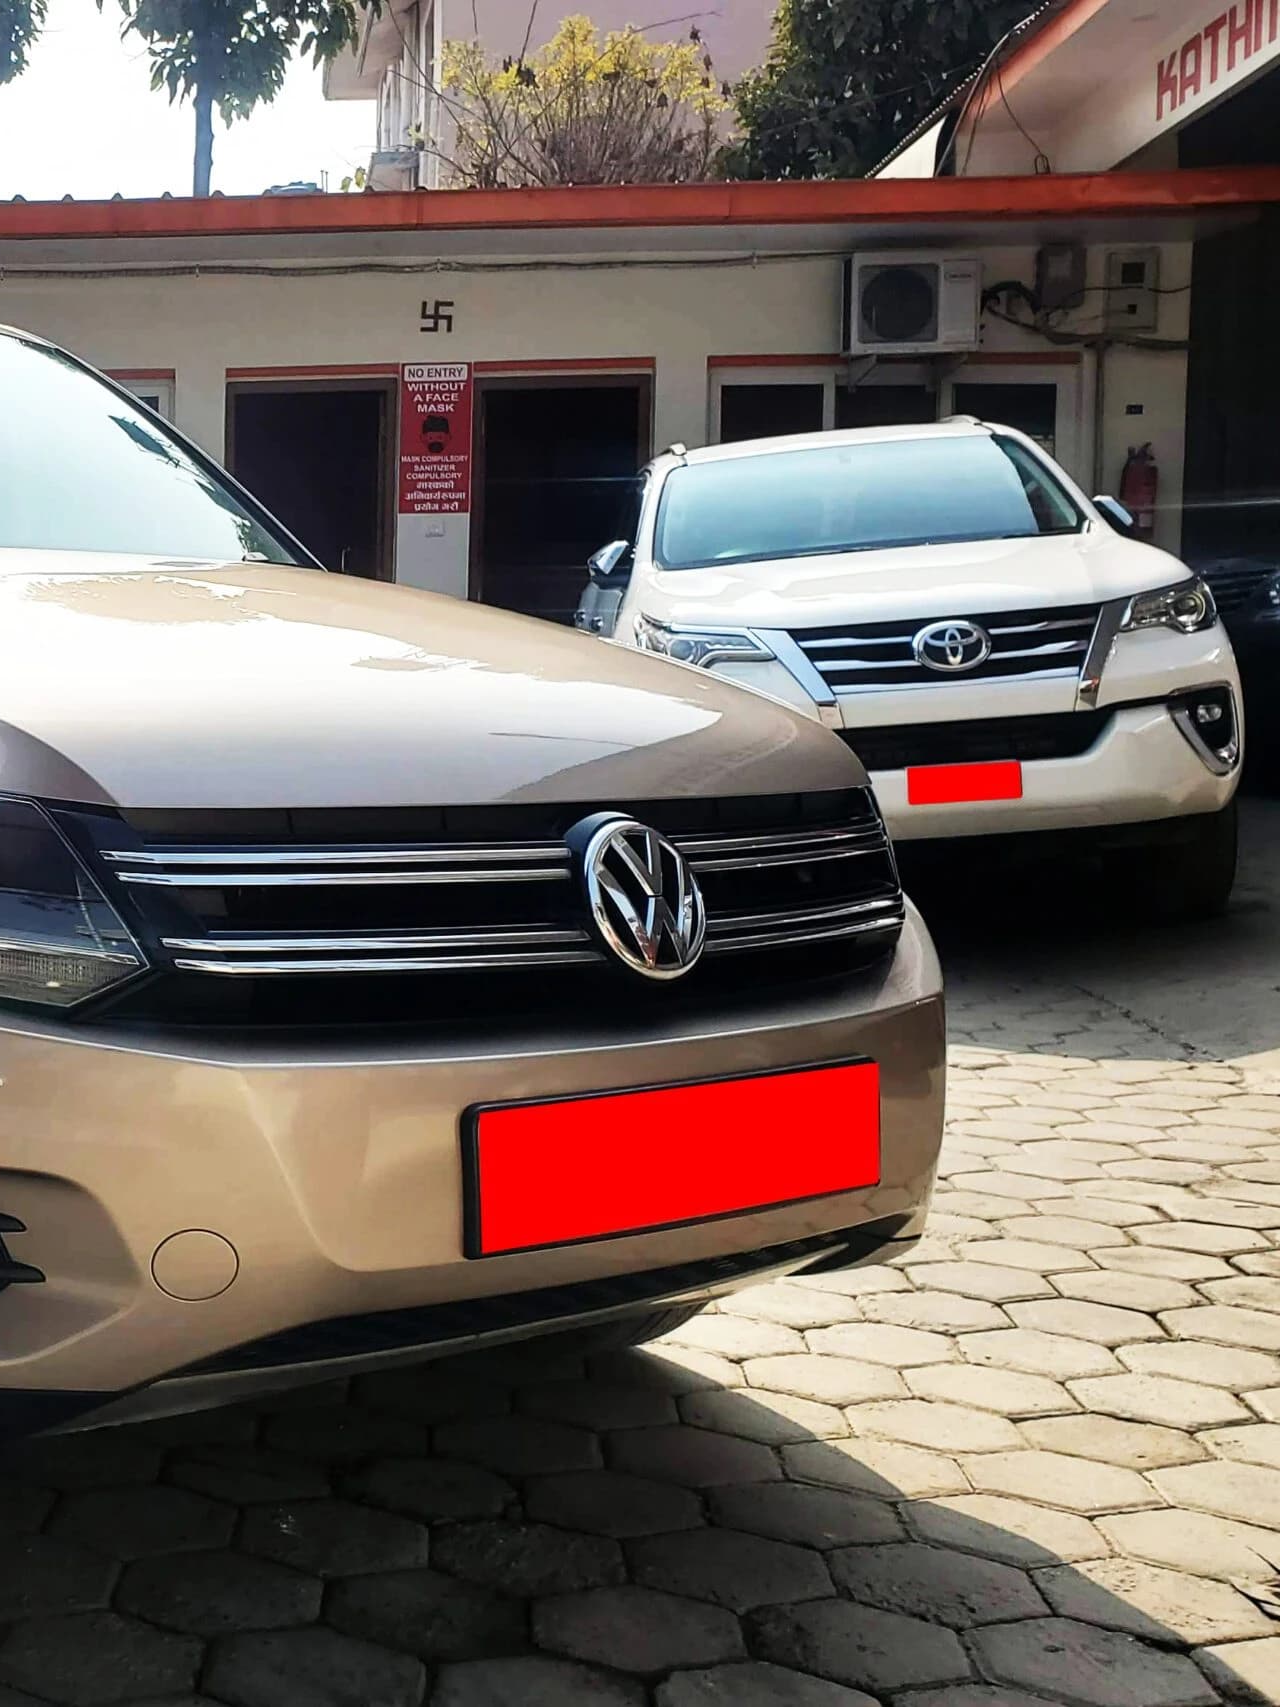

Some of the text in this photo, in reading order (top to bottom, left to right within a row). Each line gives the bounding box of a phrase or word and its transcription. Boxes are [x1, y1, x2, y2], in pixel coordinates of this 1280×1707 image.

[408, 367, 464, 378] NO ENTRY
[407, 382, 466, 391] WITHOUT
[413, 392, 459, 402] A FACE
[417, 403, 454, 413] MASK
[406, 472, 462, 480] COMPULSORY
